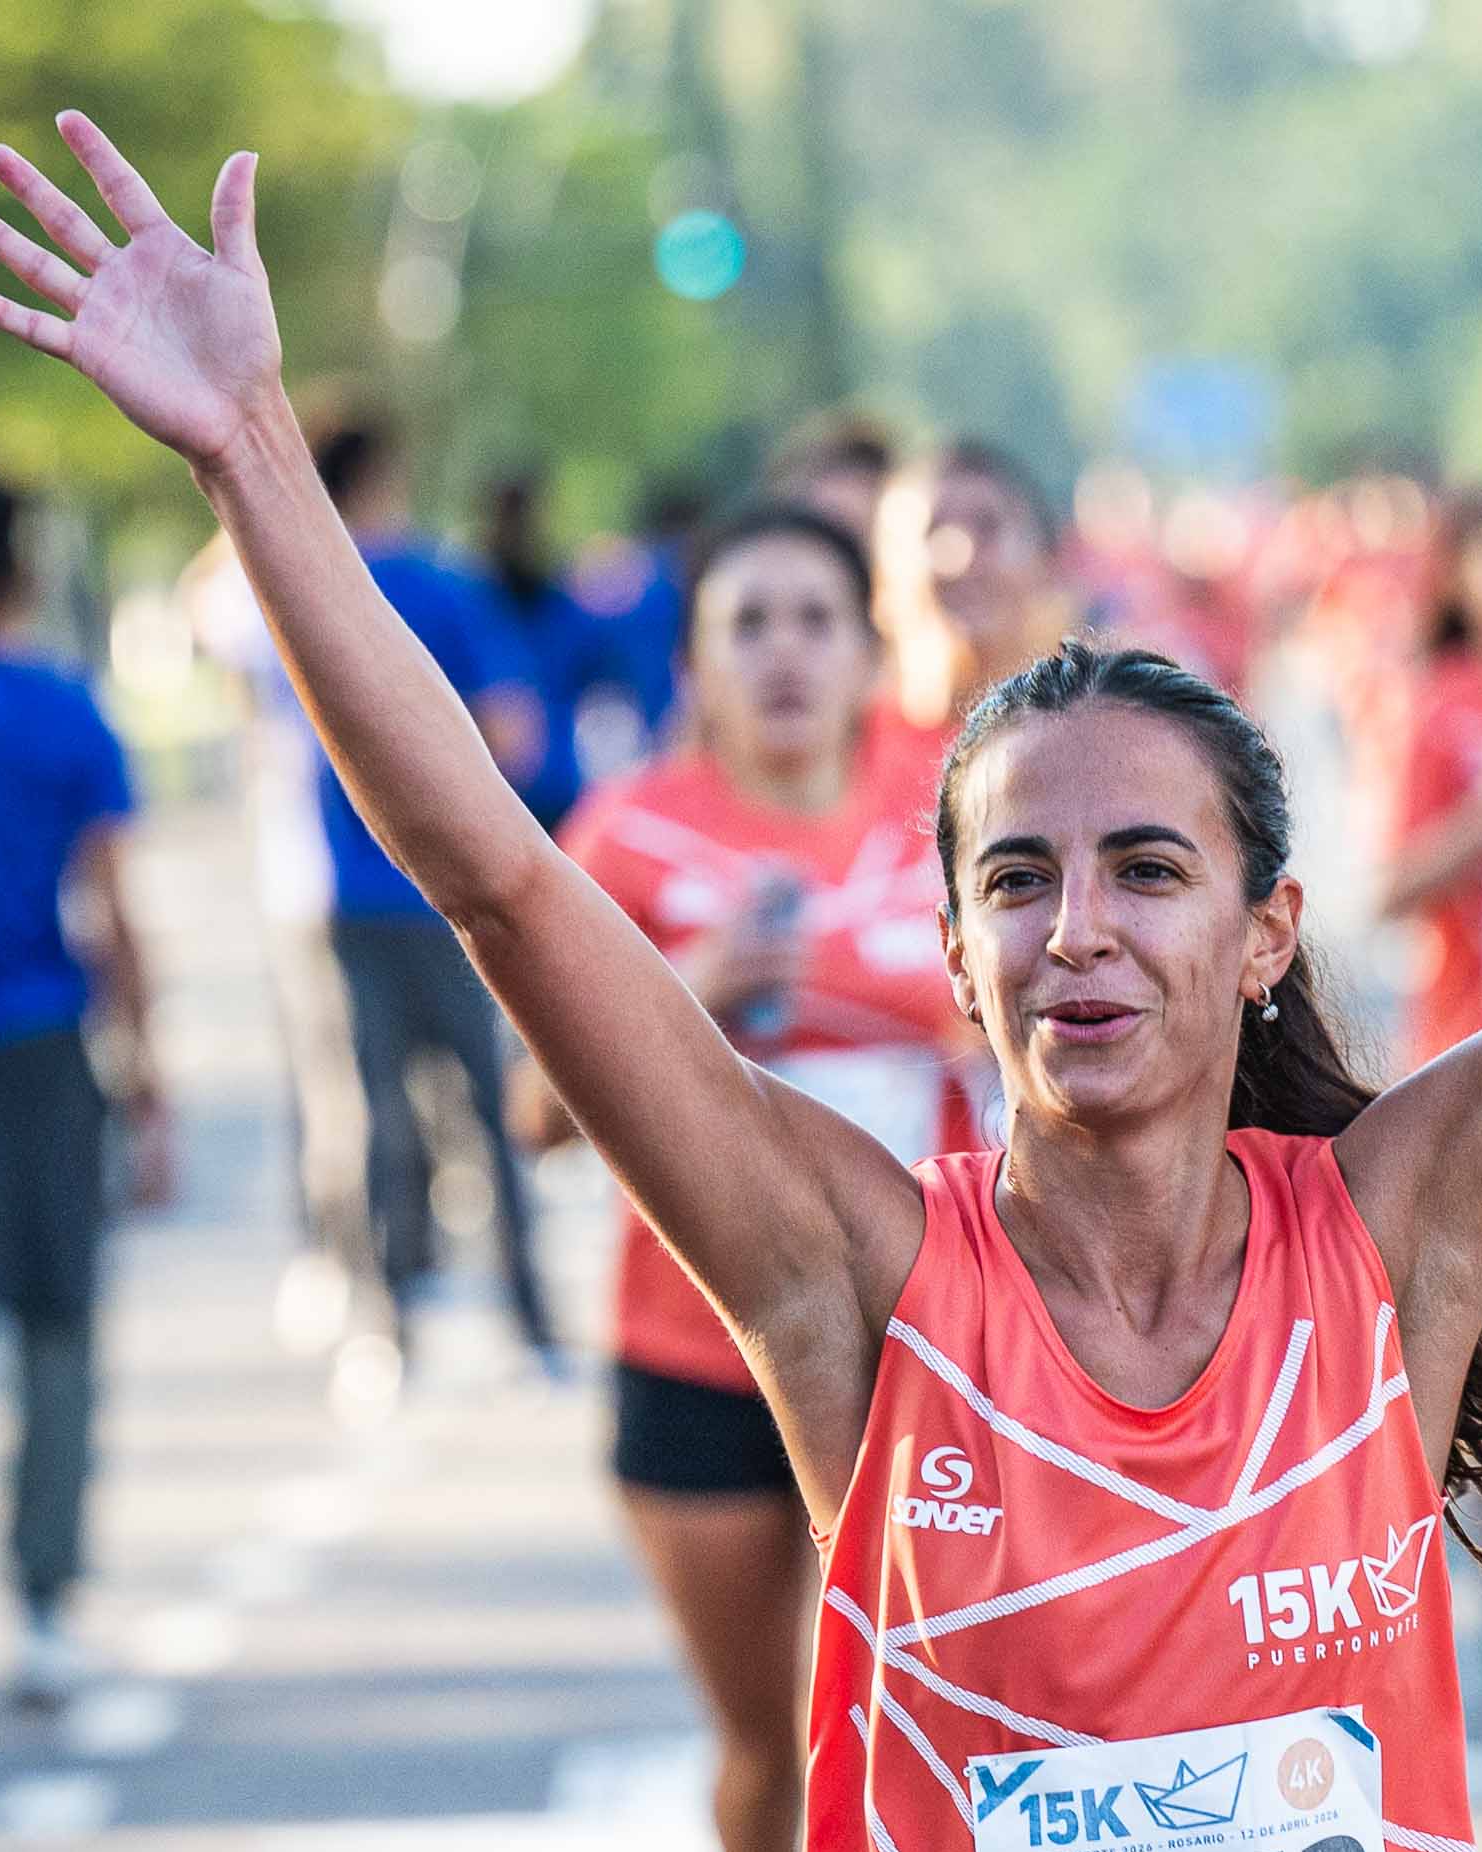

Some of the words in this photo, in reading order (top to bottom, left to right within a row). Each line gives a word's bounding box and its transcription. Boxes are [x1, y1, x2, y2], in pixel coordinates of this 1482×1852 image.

[1228, 1559, 1362, 1645] 15K
[1289, 1757, 1326, 1790] 4K
[1020, 1785, 1132, 1847] 15K
[1168, 1833, 1225, 1849] ROSARIO
[1241, 1830, 1254, 1841] 12
[1260, 1826, 1275, 1837] DE
[1280, 1818, 1310, 1834] ABRIL
